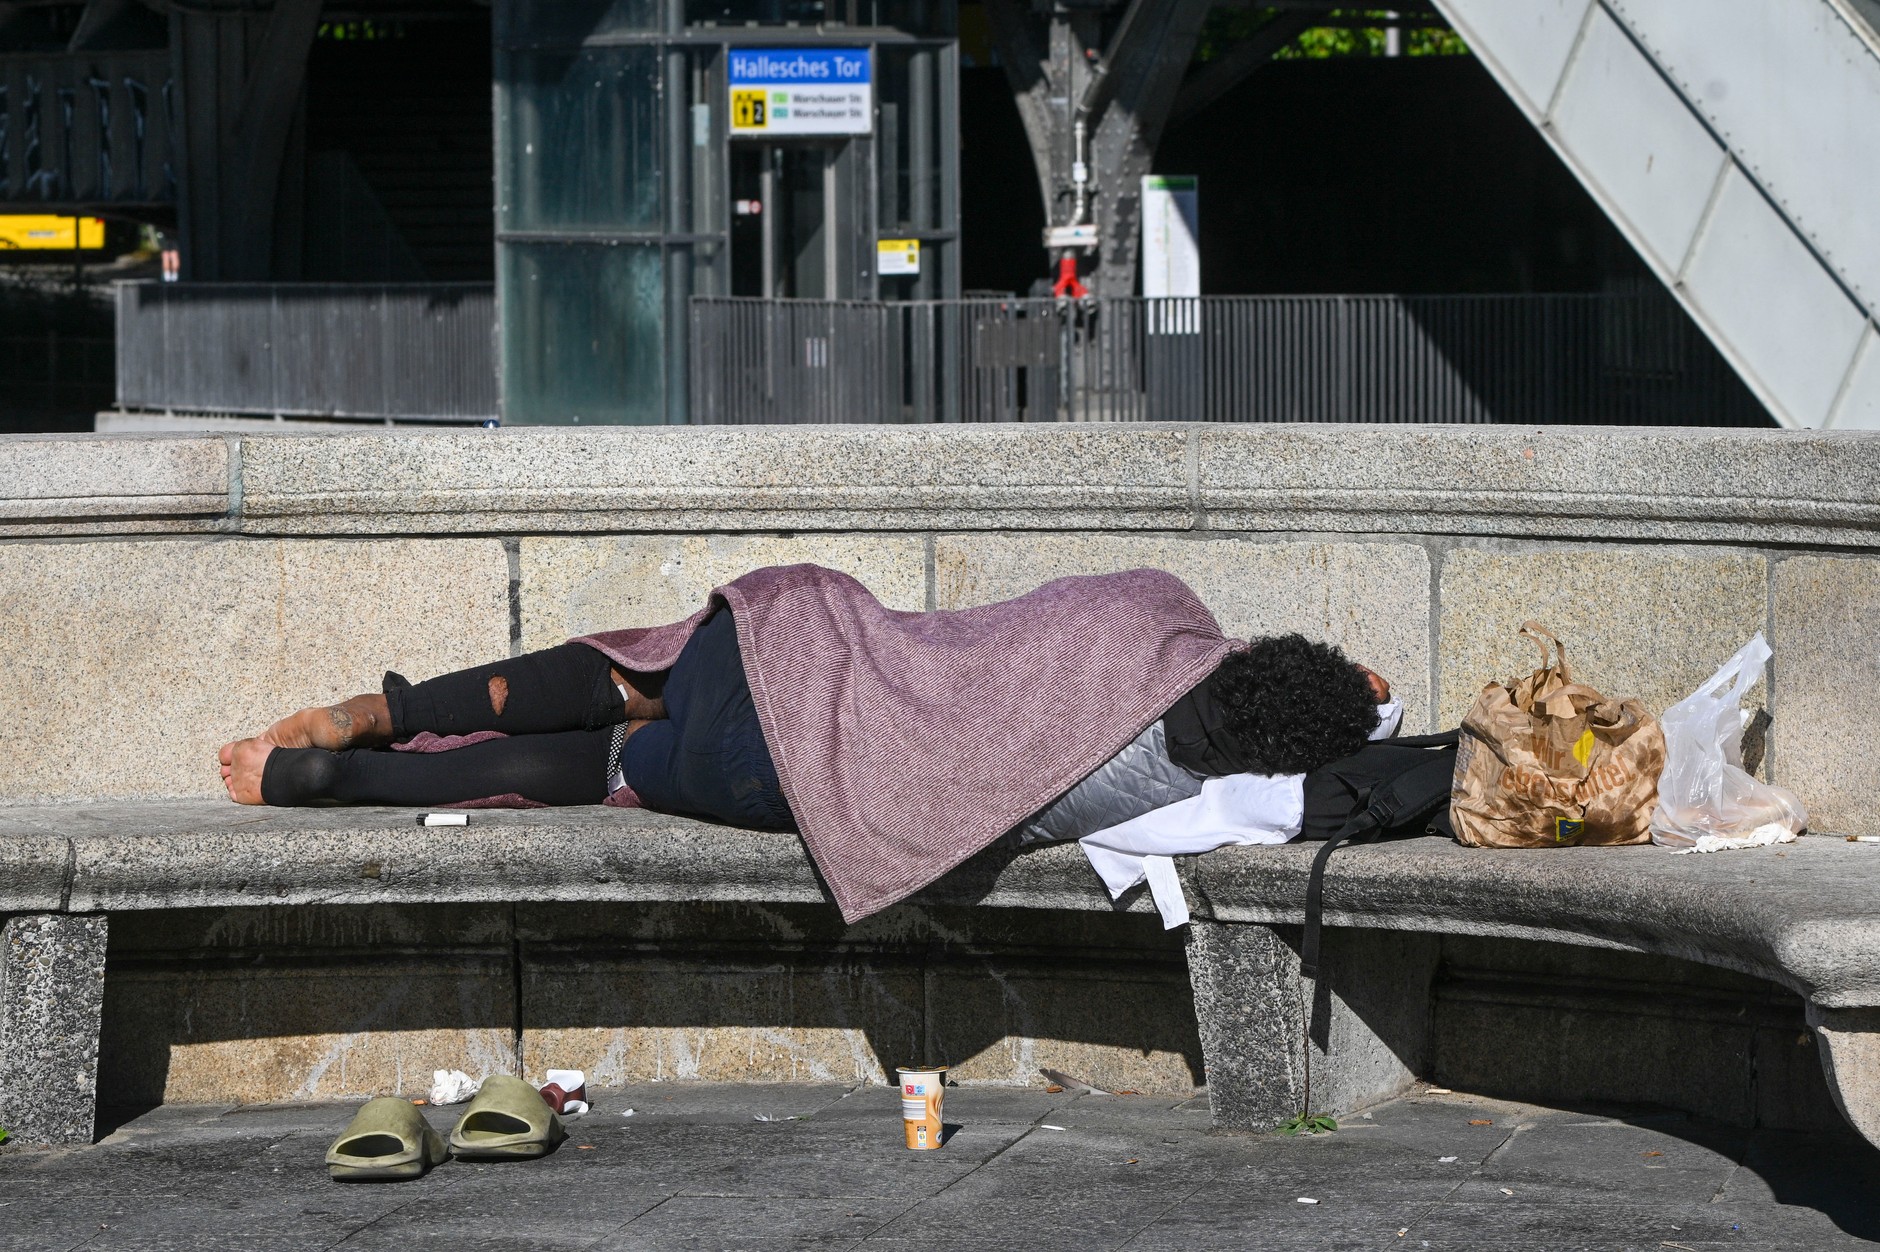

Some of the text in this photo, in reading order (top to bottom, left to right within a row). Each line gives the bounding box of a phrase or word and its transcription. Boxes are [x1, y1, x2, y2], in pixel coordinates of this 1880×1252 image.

[733, 56, 862, 78] Hallesches Tor
[754, 103, 763, 122] 2
[1531, 734, 1566, 771] Wir
